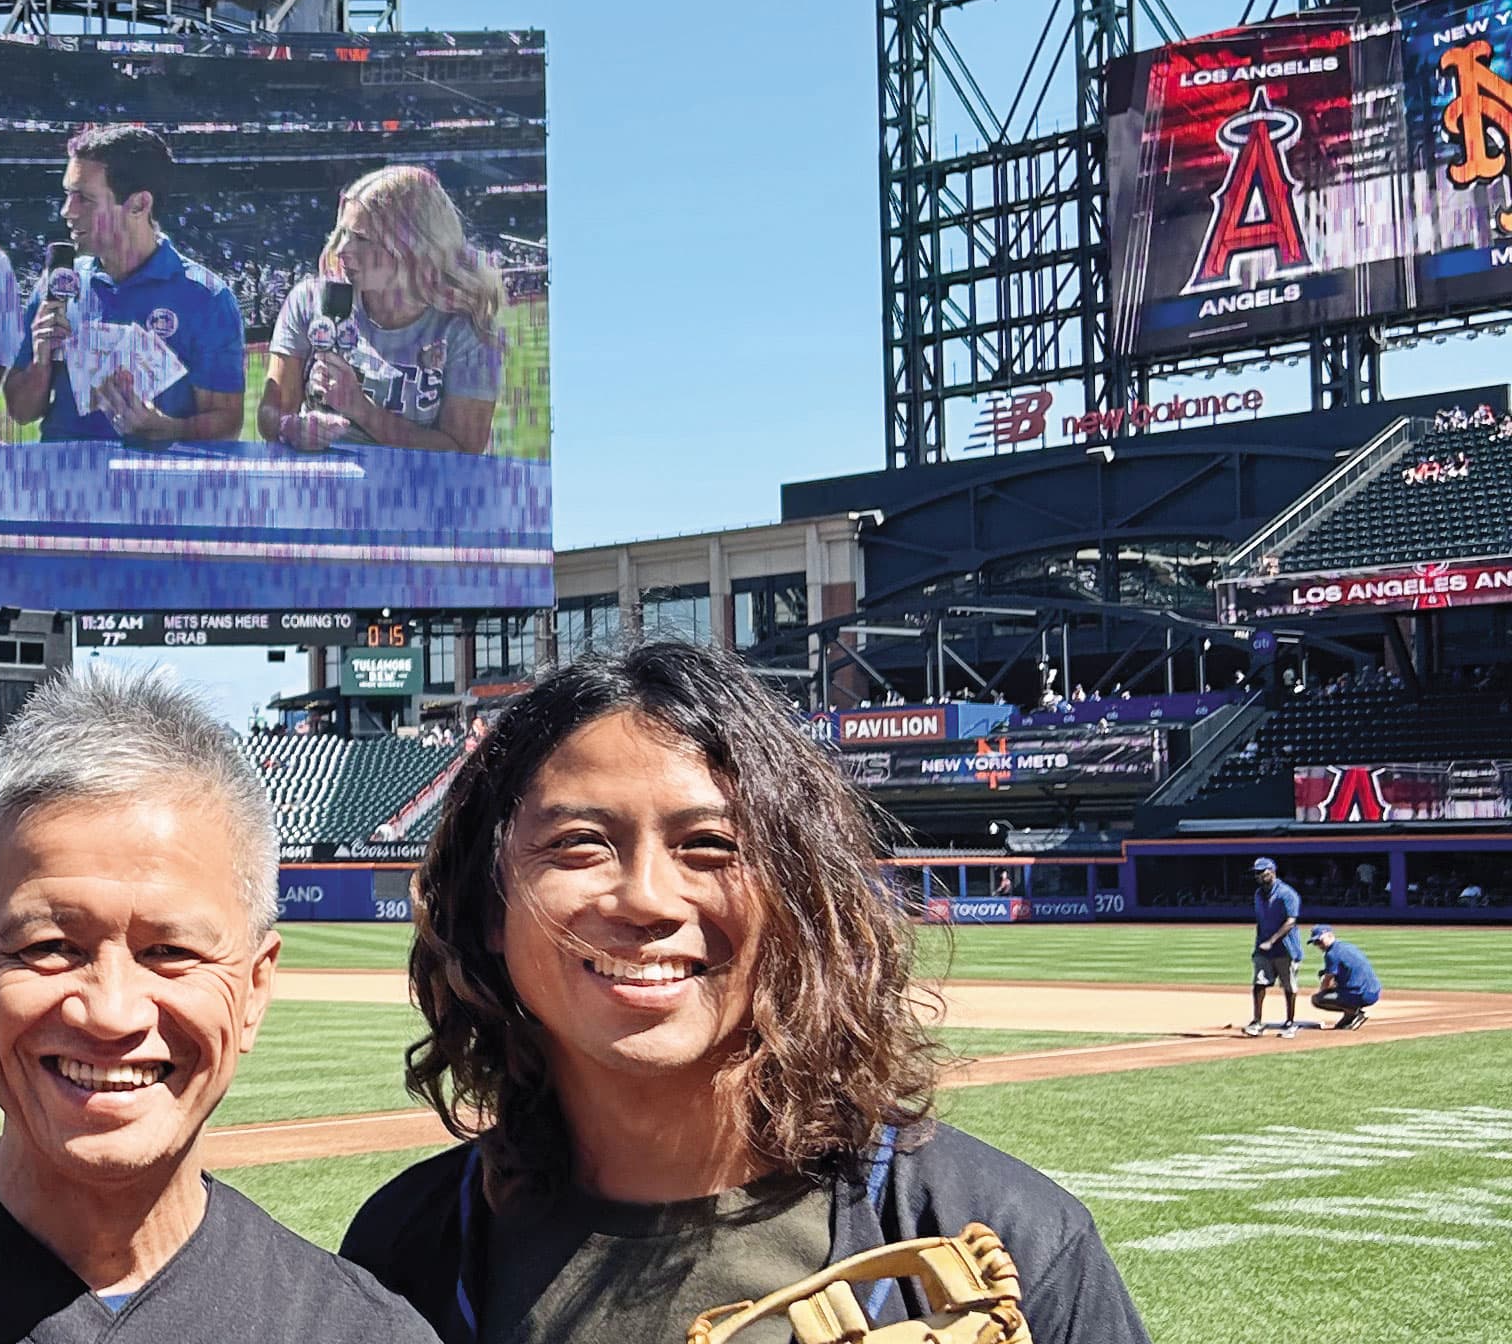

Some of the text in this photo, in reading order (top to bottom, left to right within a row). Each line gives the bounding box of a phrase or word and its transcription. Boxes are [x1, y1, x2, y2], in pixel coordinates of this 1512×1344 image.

[1433, 17, 1489, 46] NEW
[1180, 57, 1338, 87] LOS ANGELES
[1198, 284, 1301, 318] ANGELS
[1062, 389, 1264, 436] new balance
[1292, 586, 1342, 606] LOS
[1347, 574, 1468, 601] ANGELES
[118, 616, 143, 630] AM
[164, 614, 351, 629] METS FANS HERE COMING TO
[164, 632, 207, 646] GRAB
[845, 715, 938, 739] PAVILION
[921, 754, 1068, 773] NEW YORK METS
[350, 838, 428, 857] Coors LIGHT
[375, 900, 407, 918] 380
[954, 902, 1008, 916] TOYOTA
[1034, 902, 1089, 916] TOYOTA
[1094, 894, 1124, 913] 370
